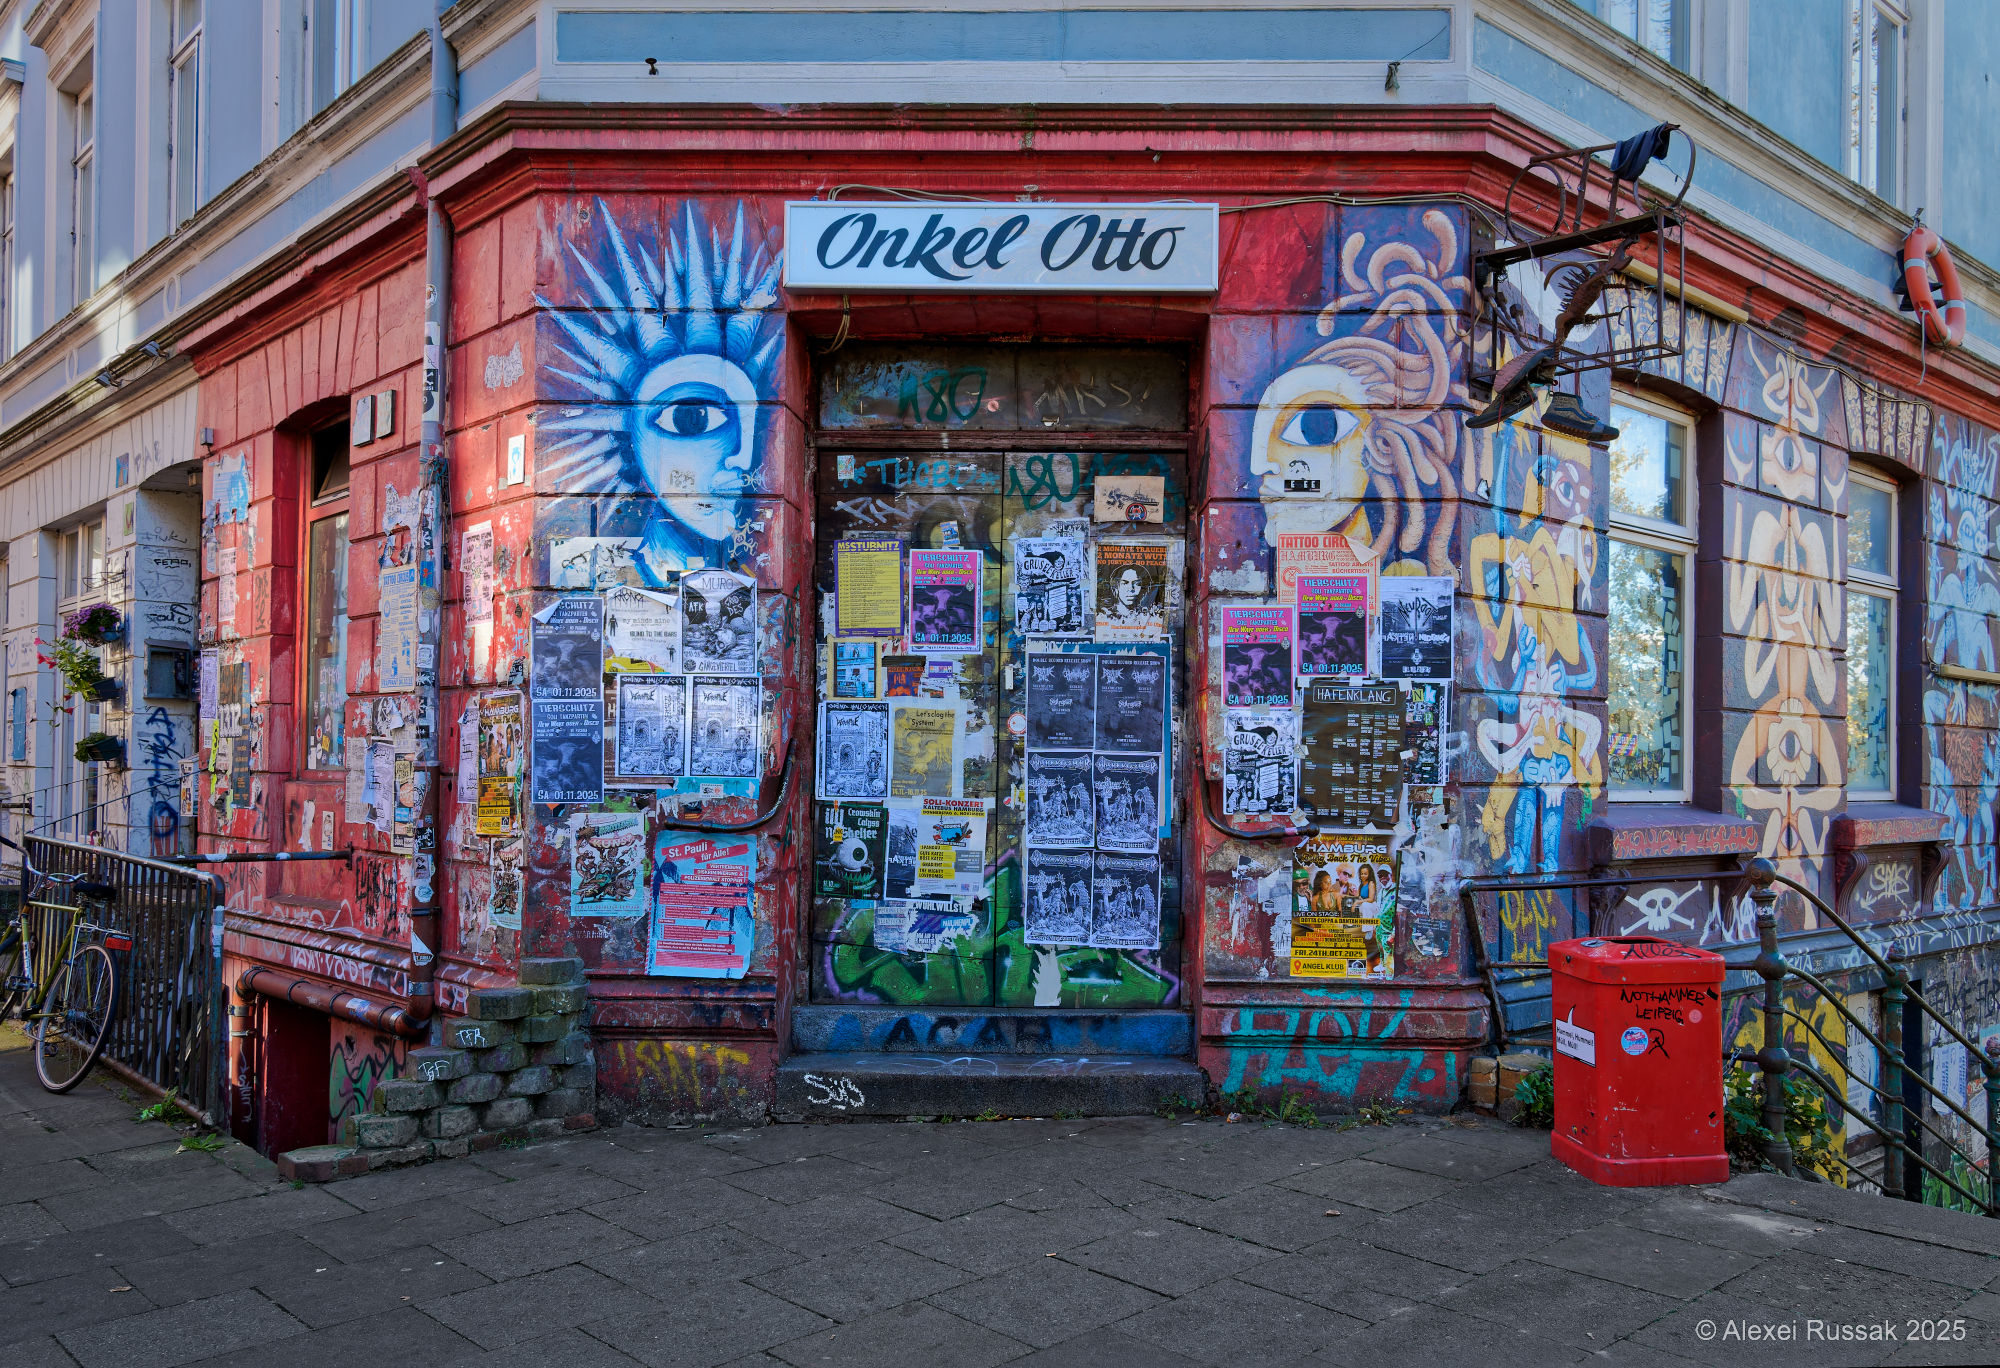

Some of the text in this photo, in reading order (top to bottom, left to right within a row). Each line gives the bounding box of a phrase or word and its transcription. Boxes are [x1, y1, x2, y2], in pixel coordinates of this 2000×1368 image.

[816, 213, 1186, 281] Onkel Otto
[1281, 536, 1319, 548] TATTOO
[918, 554, 969, 562] TIERSCHUTZ
[1104, 552, 1141, 560] MONATE
[1281, 551, 1336, 562] HAMBURG
[702, 577, 734, 590] MURO
[1229, 610, 1284, 618] TIERSCHUTZ
[915, 633, 972, 643] SA 01.11.2025
[1302, 663, 1363, 673] SA 01.11.2025
[536, 687, 597, 697] SA 01.11.2025
[1317, 688, 1392, 702] HAFENKLANG
[1227, 695, 1289, 705] SA 01.11.2025
[539, 704, 595, 712] TIERSCHUTZ
[911, 719, 936, 728] System!
[538, 790, 599, 800] SA 01.11.2025
[923, 798, 984, 808] SOLI-KONZERT
[668, 841, 708, 858] St. Pauli
[701, 847, 730, 861] für Alle!
[1306, 844, 1387, 854] HAMBURG
[1328, 853, 1348, 862] Back
[1350, 854, 1368, 863] The
[1302, 961, 1345, 970] ANGEL KLUB
[1620, 987, 1706, 1006] NOTHAMMER
[1635, 1004, 1685, 1024] LEIPZIG
